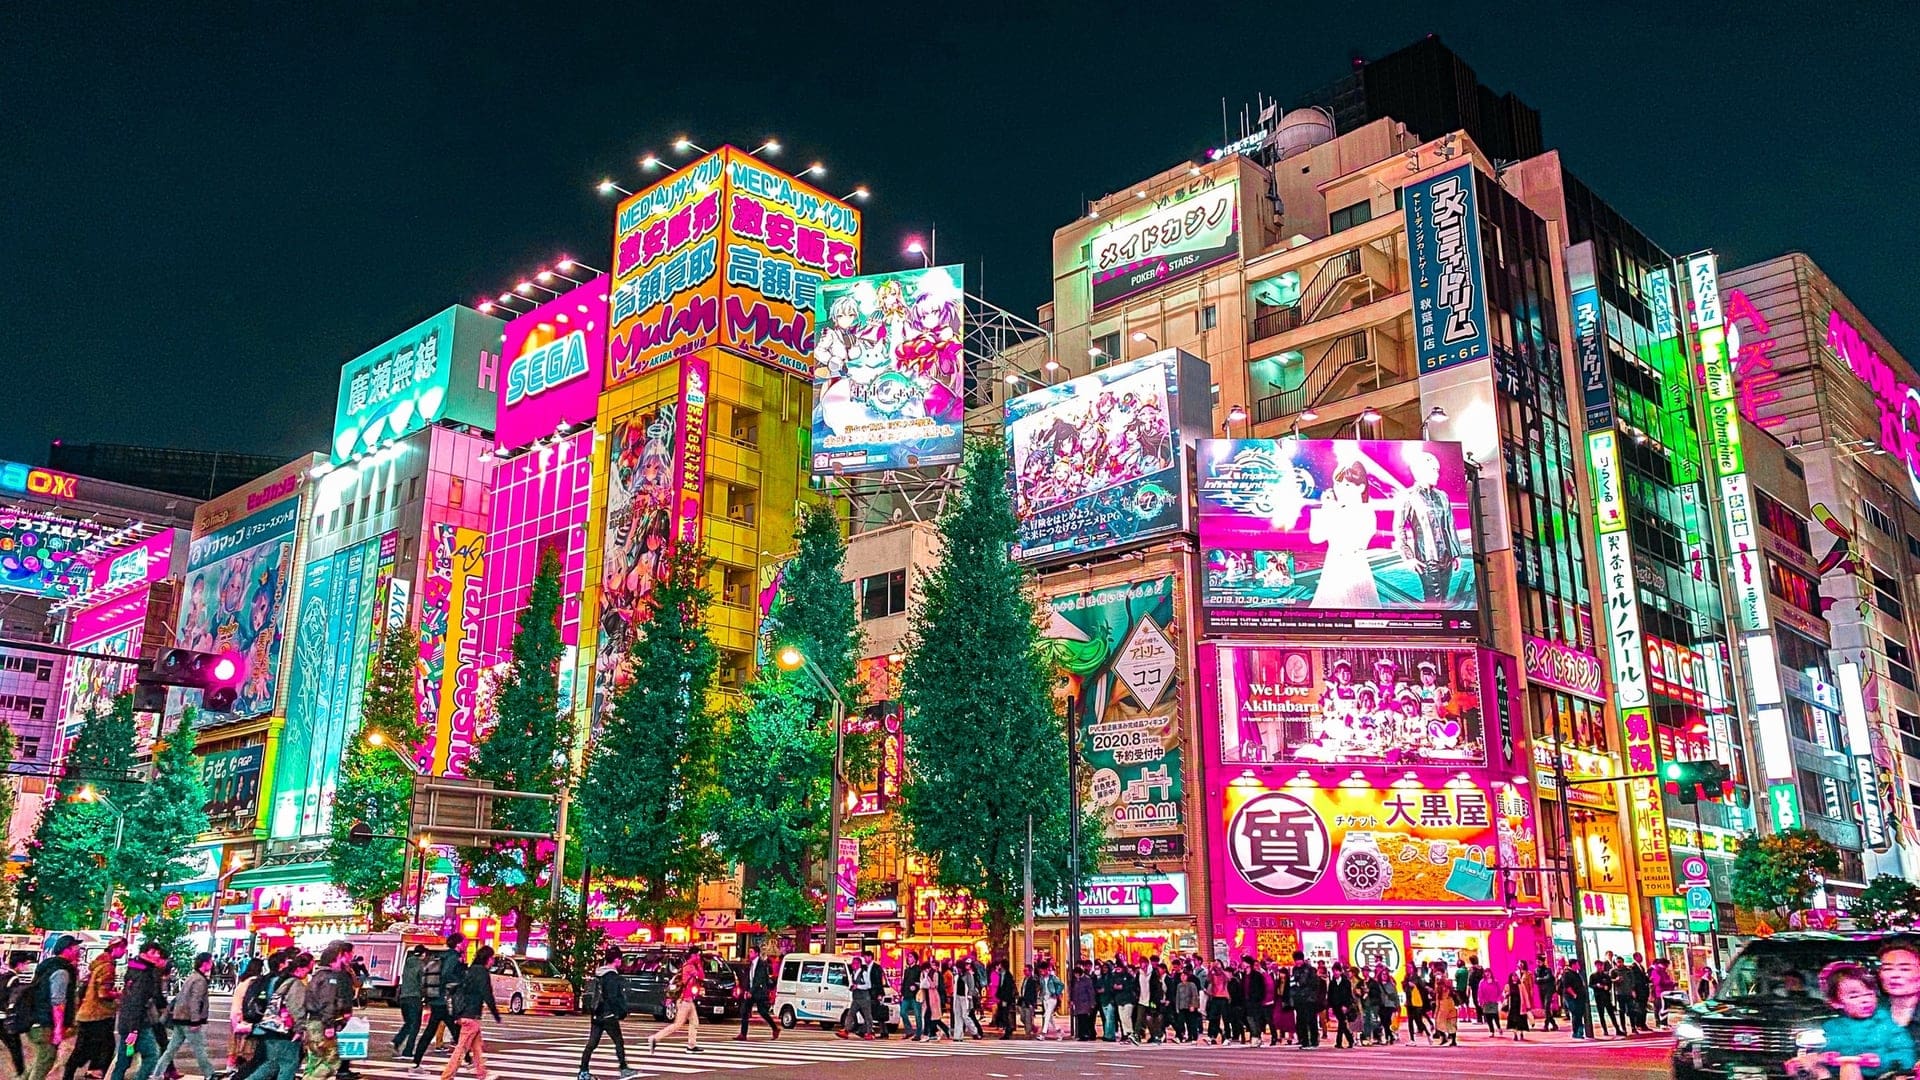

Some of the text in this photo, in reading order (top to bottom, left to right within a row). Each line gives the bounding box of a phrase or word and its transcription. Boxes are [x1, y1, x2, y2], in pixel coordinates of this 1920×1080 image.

[617, 191, 719, 274] 激安販売
[732, 195, 855, 277] 激安販売
[1099, 198, 1228, 269] メイドカジノ
[614, 239, 717, 326] 高額買取
[729, 246, 817, 310] 高額買
[1131, 269, 1156, 286] POKER
[1419, 298, 1436, 351] 秋葉原店
[505, 331, 588, 406] SEGA
[779, 356, 808, 374] AKIBA
[1706, 359, 1722, 398] Yellow
[1713, 405, 1733, 469] Submarine
[1600, 457, 1614, 502] りらくる
[1132, 668, 1161, 687] ココ
[1524, 640, 1601, 693] メイドカジノ
[1241, 700, 1320, 713] Akihabara
[1249, 683, 1309, 698] We Love
[1095, 732, 1140, 749] 2020.8
[1115, 746, 1164, 762] 予約受付中
[1625, 713, 1655, 773] 免税
[1115, 803, 1177, 821] amiami
[1335, 815, 1378, 827] チケット
[1384, 793, 1490, 829] 大黒屋
[1648, 778, 1668, 862] TAX FREE
[1241, 808, 1322, 883] 質
[1599, 835, 1615, 883] ルノアール
[1689, 862, 1703, 874] 40
[696, 913, 730, 927] ラーメン
[1693, 893, 1701, 906] P
